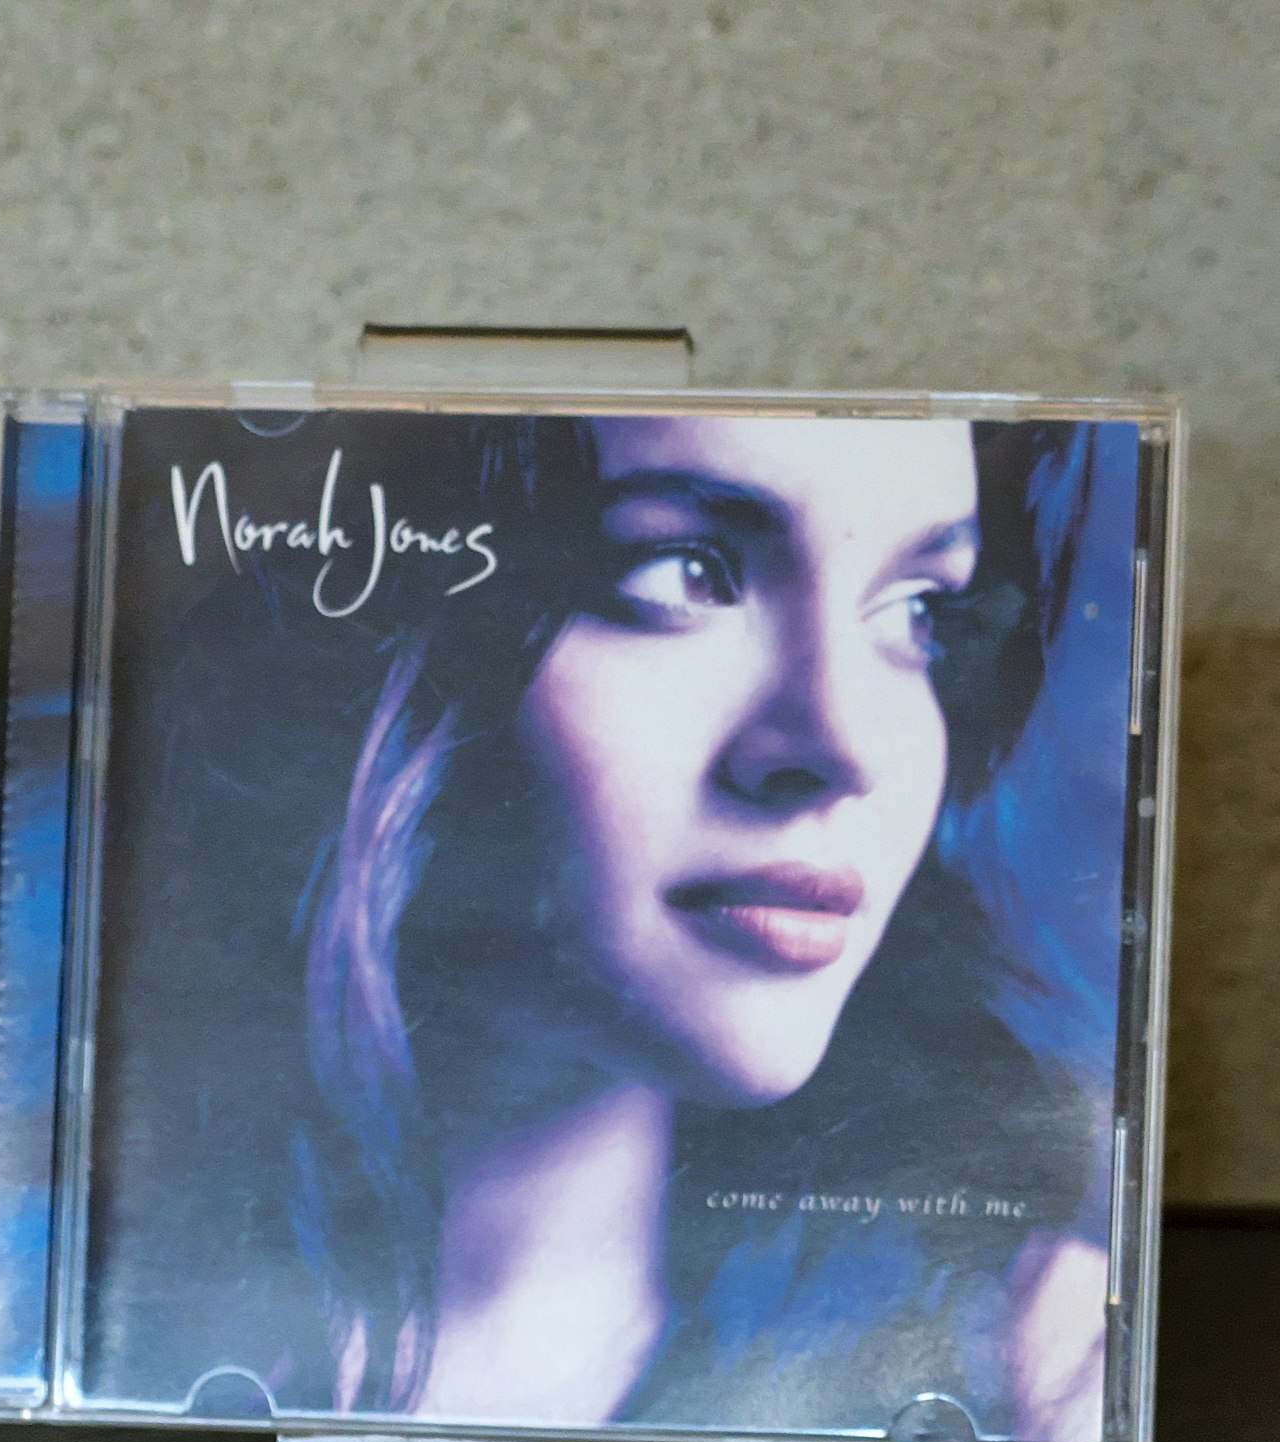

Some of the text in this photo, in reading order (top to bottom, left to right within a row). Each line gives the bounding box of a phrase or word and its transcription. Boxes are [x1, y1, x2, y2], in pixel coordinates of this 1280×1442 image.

[170, 447, 498, 619] Norah Jones
[706, 1187, 1026, 1225] come away with me
